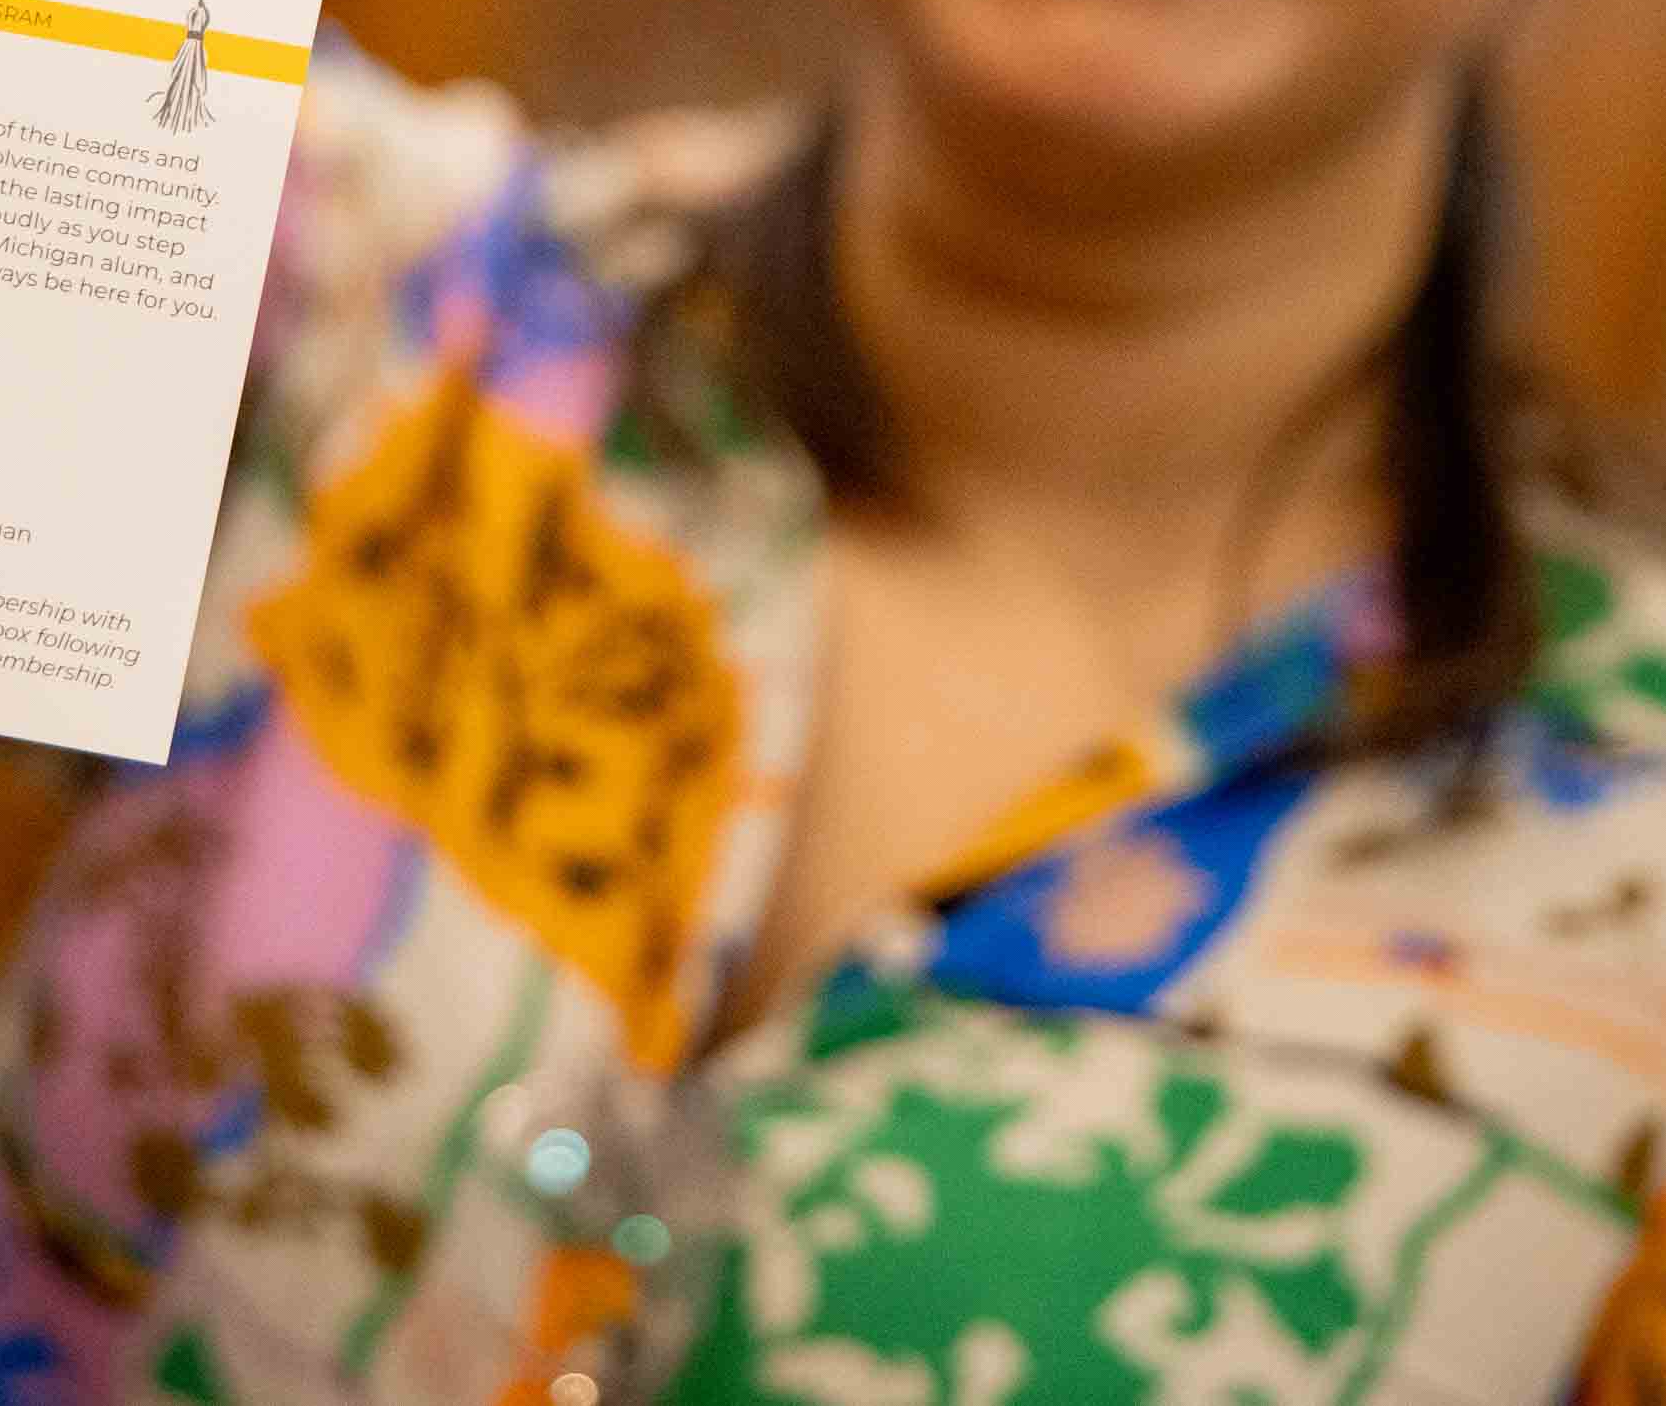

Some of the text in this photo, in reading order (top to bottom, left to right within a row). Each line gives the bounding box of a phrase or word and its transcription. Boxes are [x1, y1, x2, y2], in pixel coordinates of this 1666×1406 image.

[20, 125, 57, 146] the
[62, 131, 149, 164] Leaders
[154, 152, 199, 172] and
[0, 177, 37, 200] the
[44, 185, 120, 220] lasting
[127, 200, 207, 232] impact
[84, 168, 219, 208] community.
[57, 220, 82, 237] as
[84, 225, 129, 245] you
[135, 234, 185, 258] step
[100, 255, 162, 284] alum,
[169, 270, 214, 290] and
[44, 271, 72, 292] be
[79, 277, 130, 304] here
[136, 288, 167, 309] for
[169, 298, 217, 321] you.
[81, 611, 130, 632] with
[36, 627, 140, 666] following
